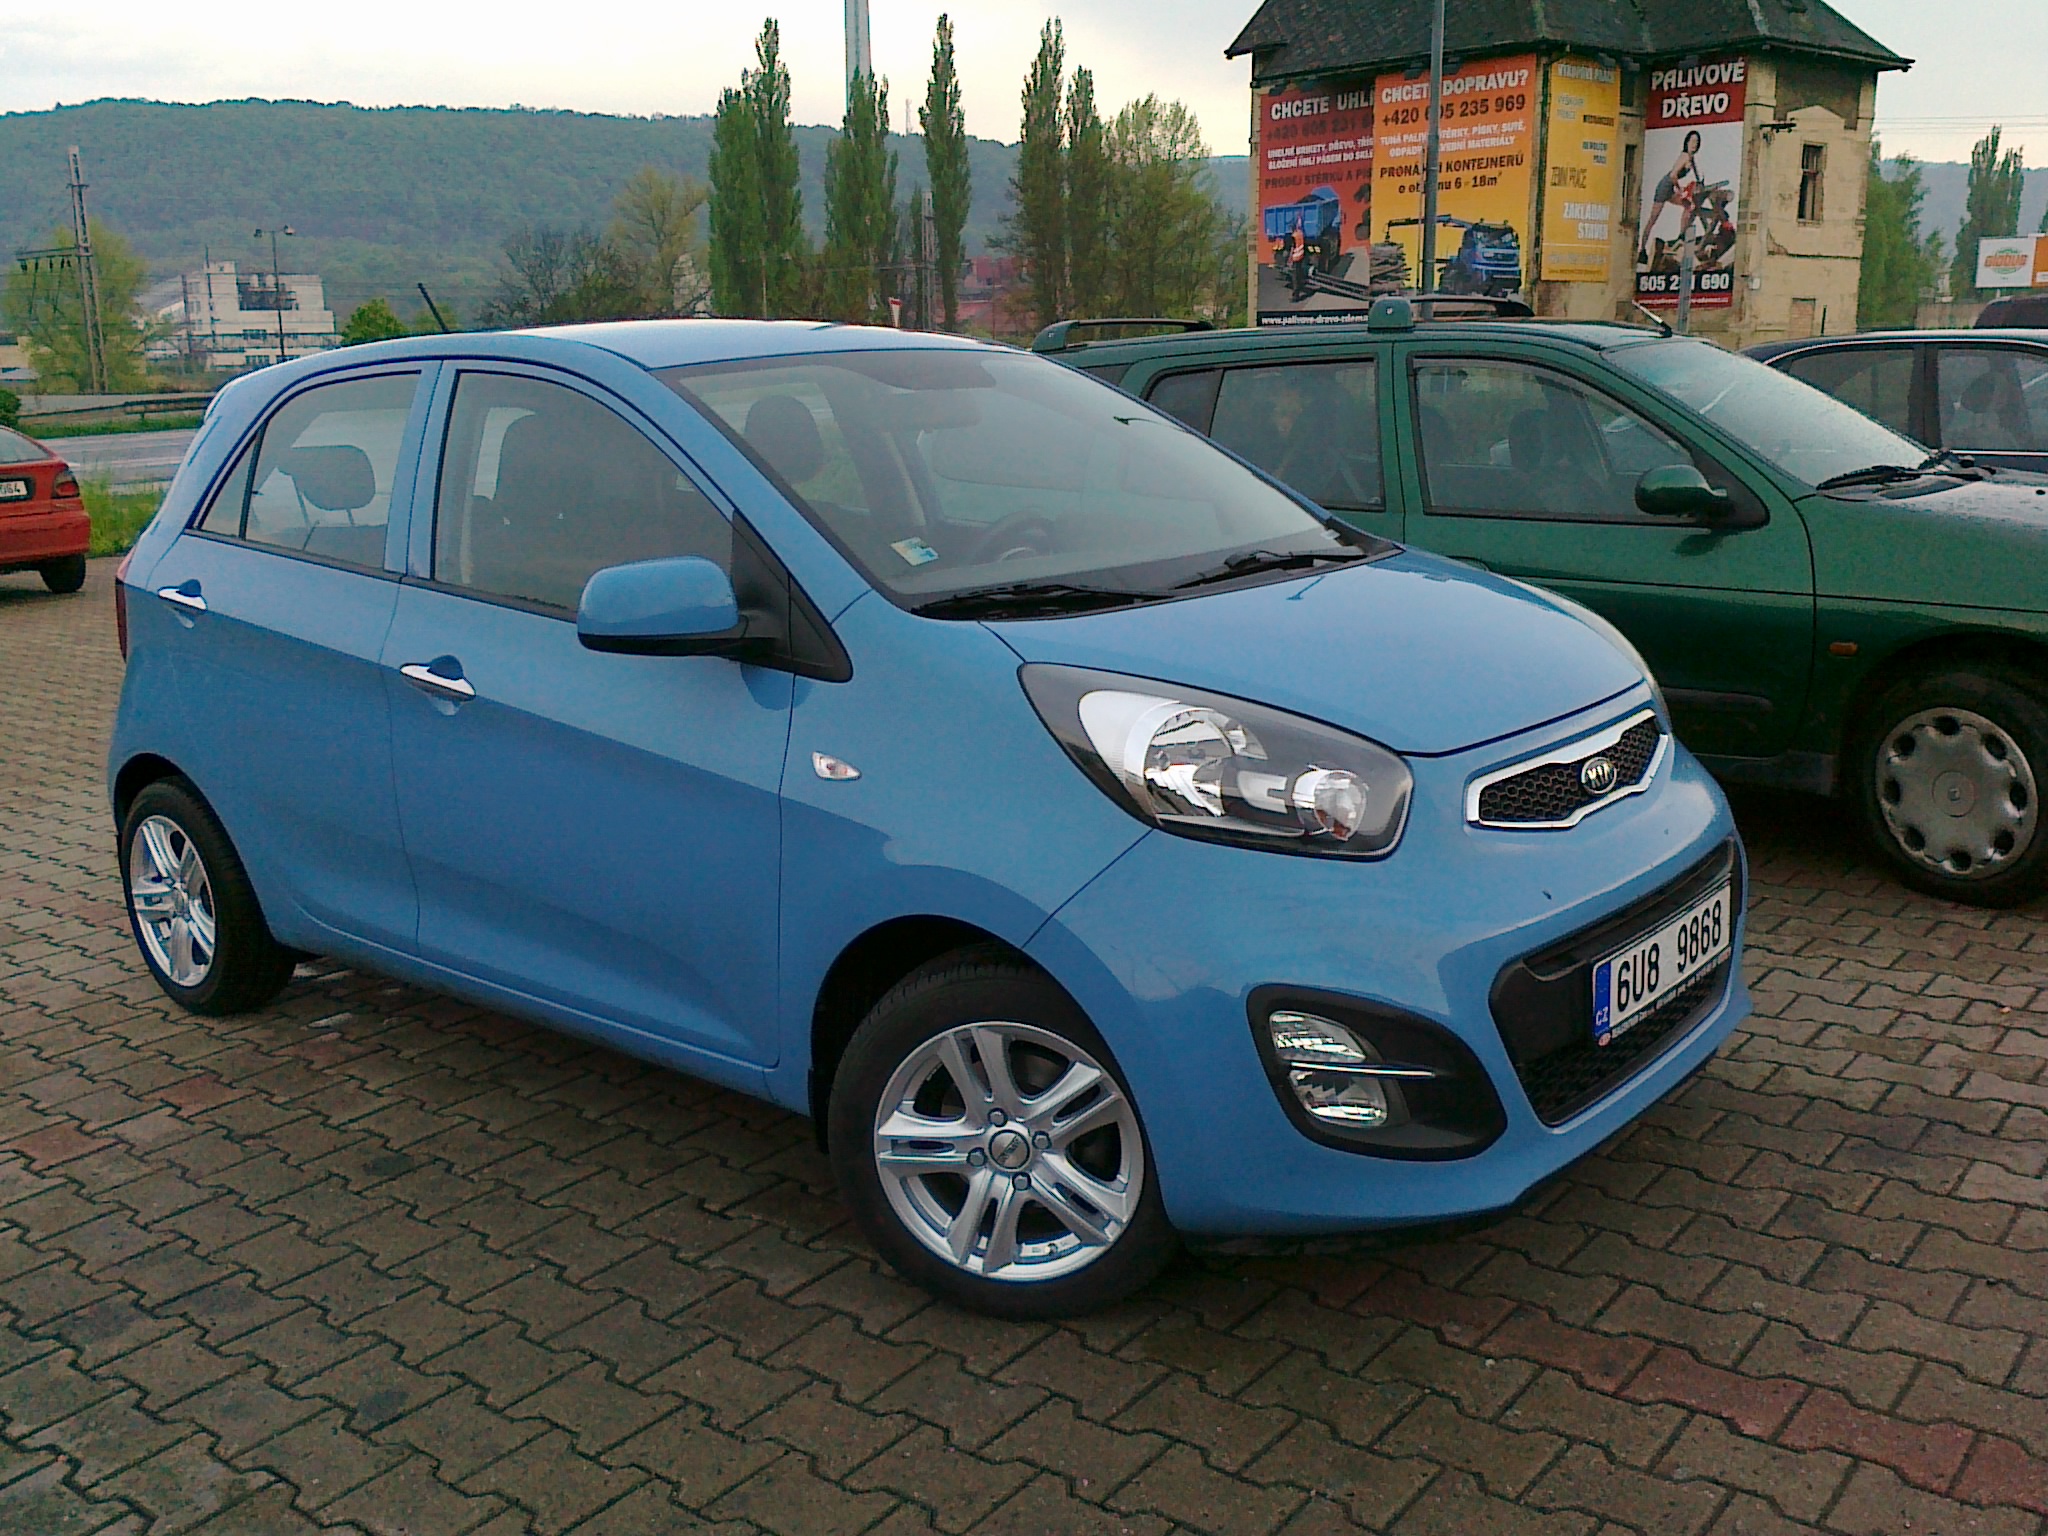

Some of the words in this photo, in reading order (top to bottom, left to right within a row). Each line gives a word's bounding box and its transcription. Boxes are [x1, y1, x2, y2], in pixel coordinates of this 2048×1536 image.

[1381, 83, 1430, 104] CHCET
[1442, 69, 1529, 96] DOPRAVU?
[1651, 57, 1745, 91] PALIVOVÉ
[1271, 96, 1330, 120] CHCETE
[1382, 107, 1419, 126] +420
[1459, 98, 1489, 117] 235
[1495, 93, 1526, 113] 969
[1662, 92, 1729, 119] DŘEVO
[1265, 175, 1302, 189] PRODEJ
[1346, 170, 1353, 182] A
[1454, 177, 1462, 190] 6
[1639, 275, 1666, 292] 605
[1701, 273, 1730, 290] 690
[1617, 943, 1660, 1012] 6U8
[1677, 899, 1721, 973] 9868
[1595, 1006, 1609, 1026] CZ
